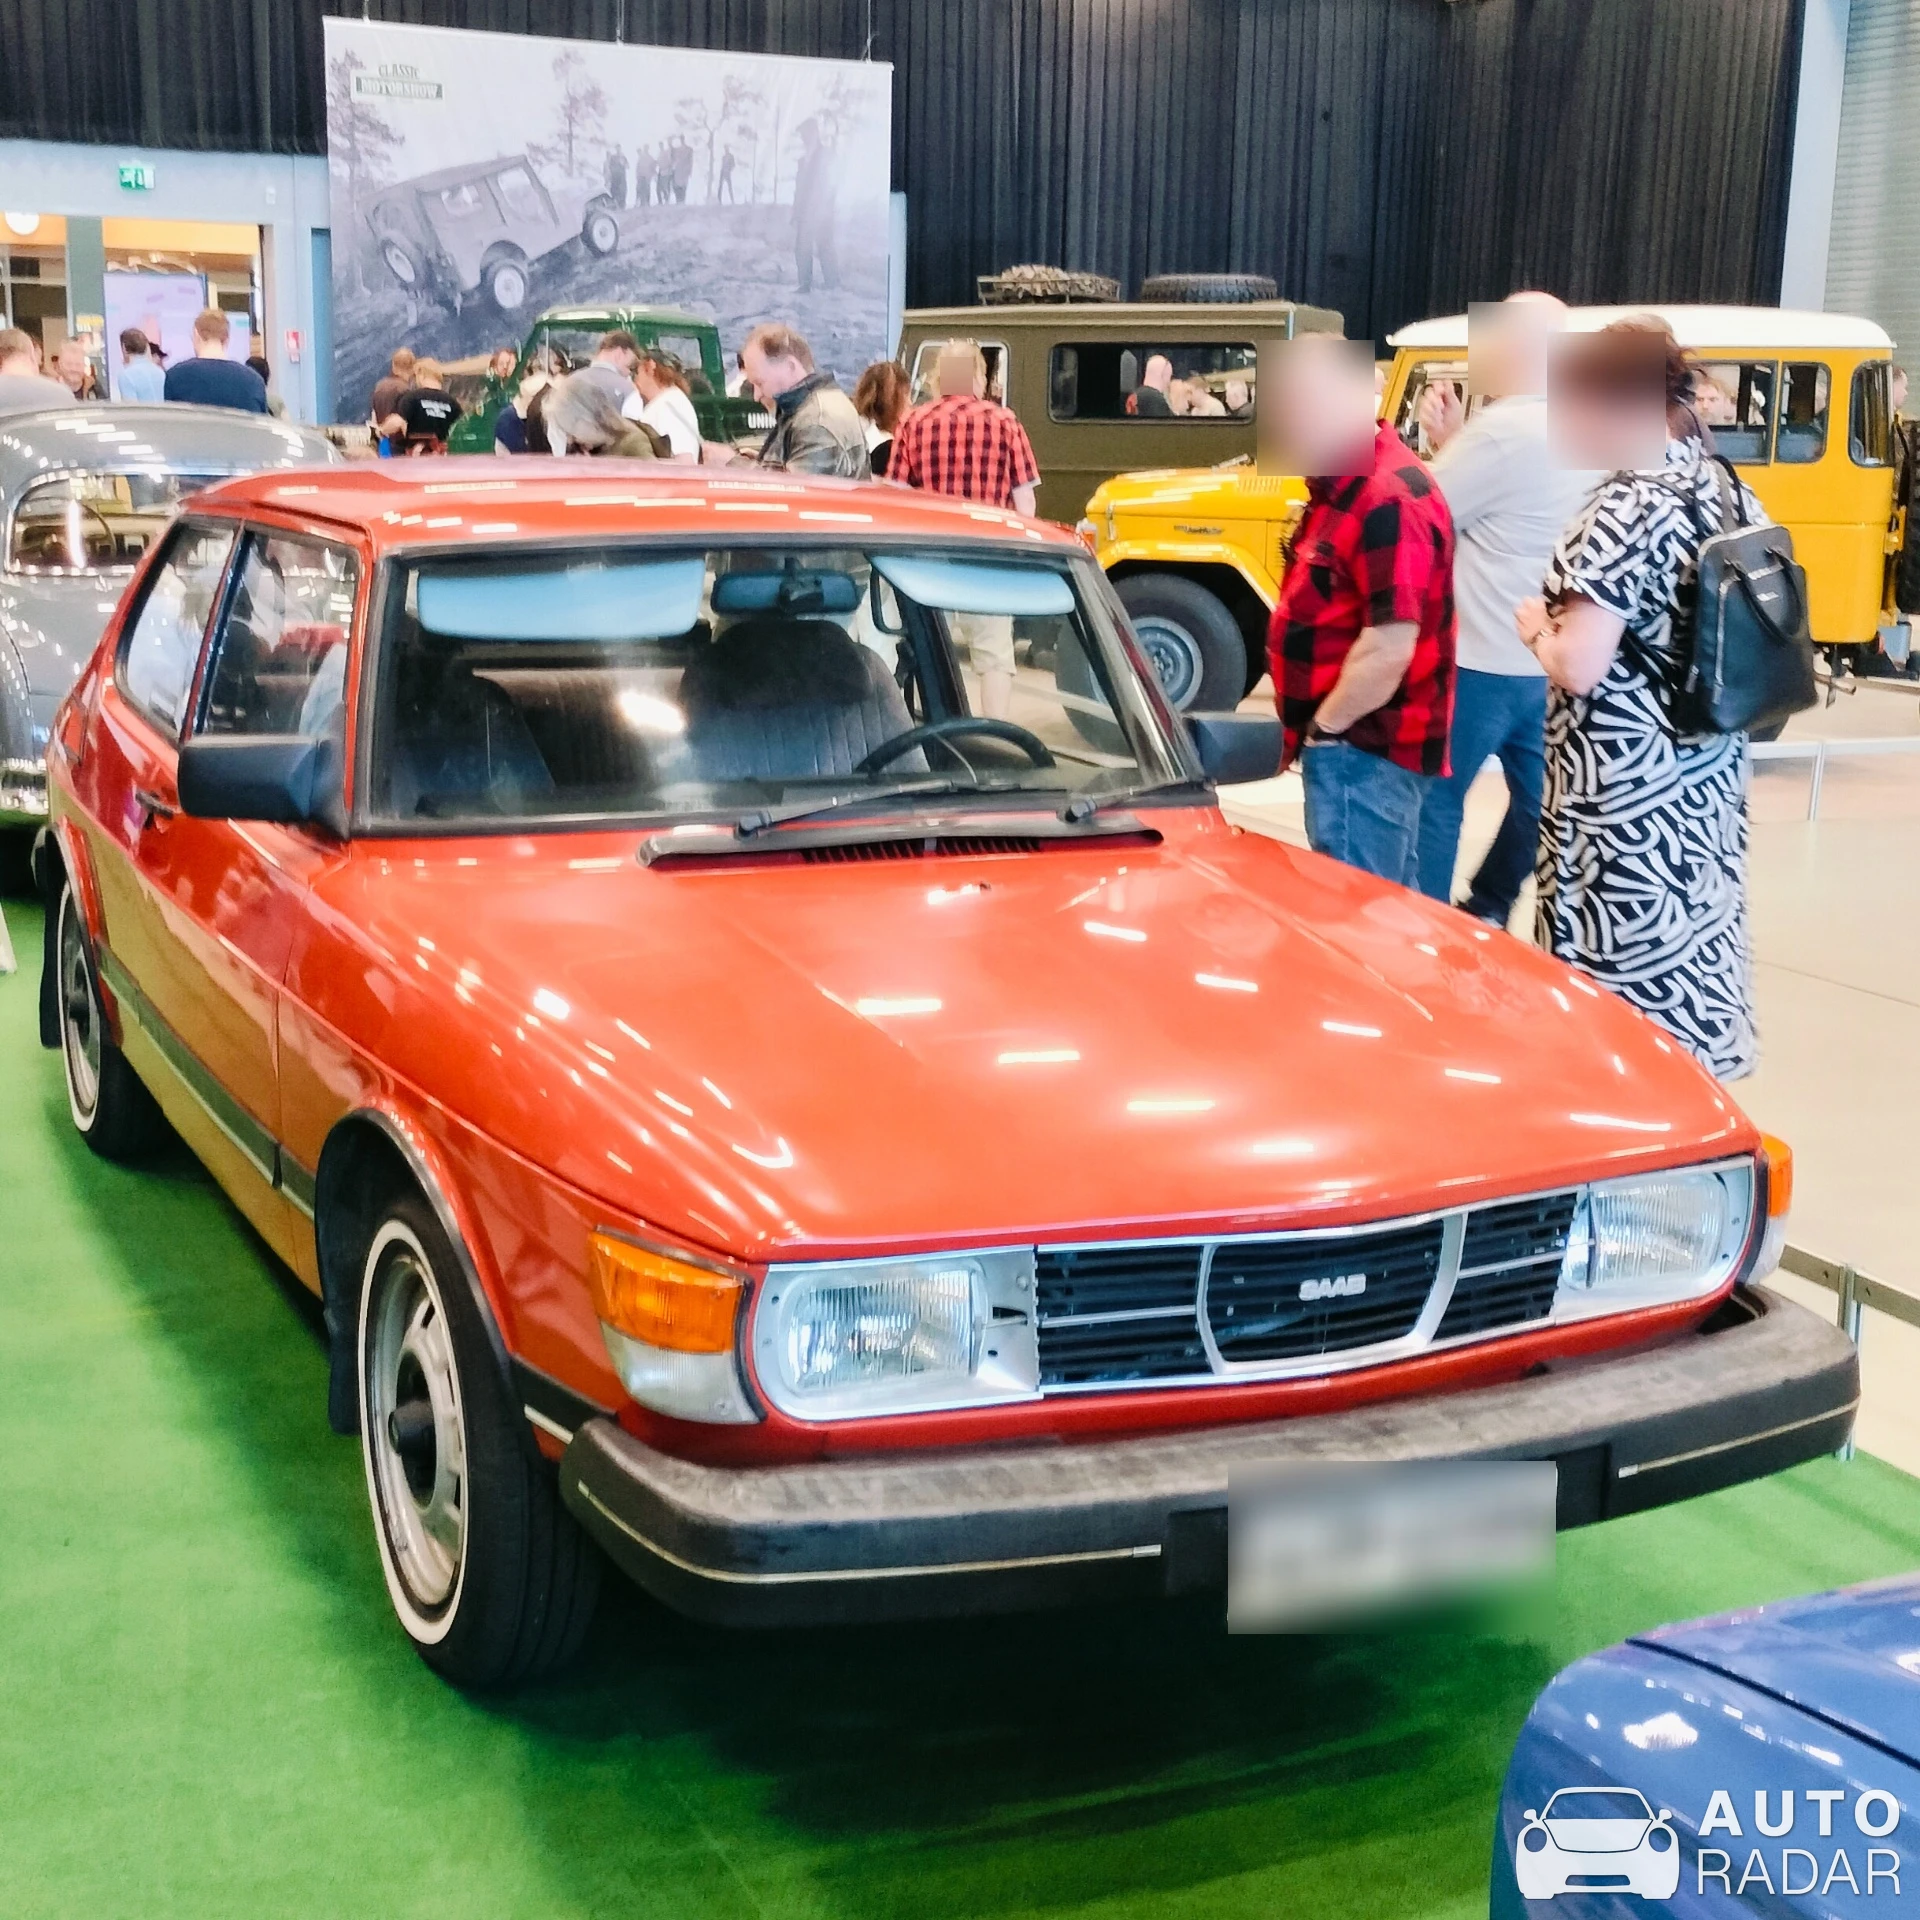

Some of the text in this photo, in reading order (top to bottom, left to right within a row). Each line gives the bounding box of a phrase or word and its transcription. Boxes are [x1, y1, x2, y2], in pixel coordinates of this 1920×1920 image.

[378, 63, 420, 80] CLASSIC
[361, 77, 440, 99] MOTORSHOW
[1299, 1273, 1367, 1302] SAAB
